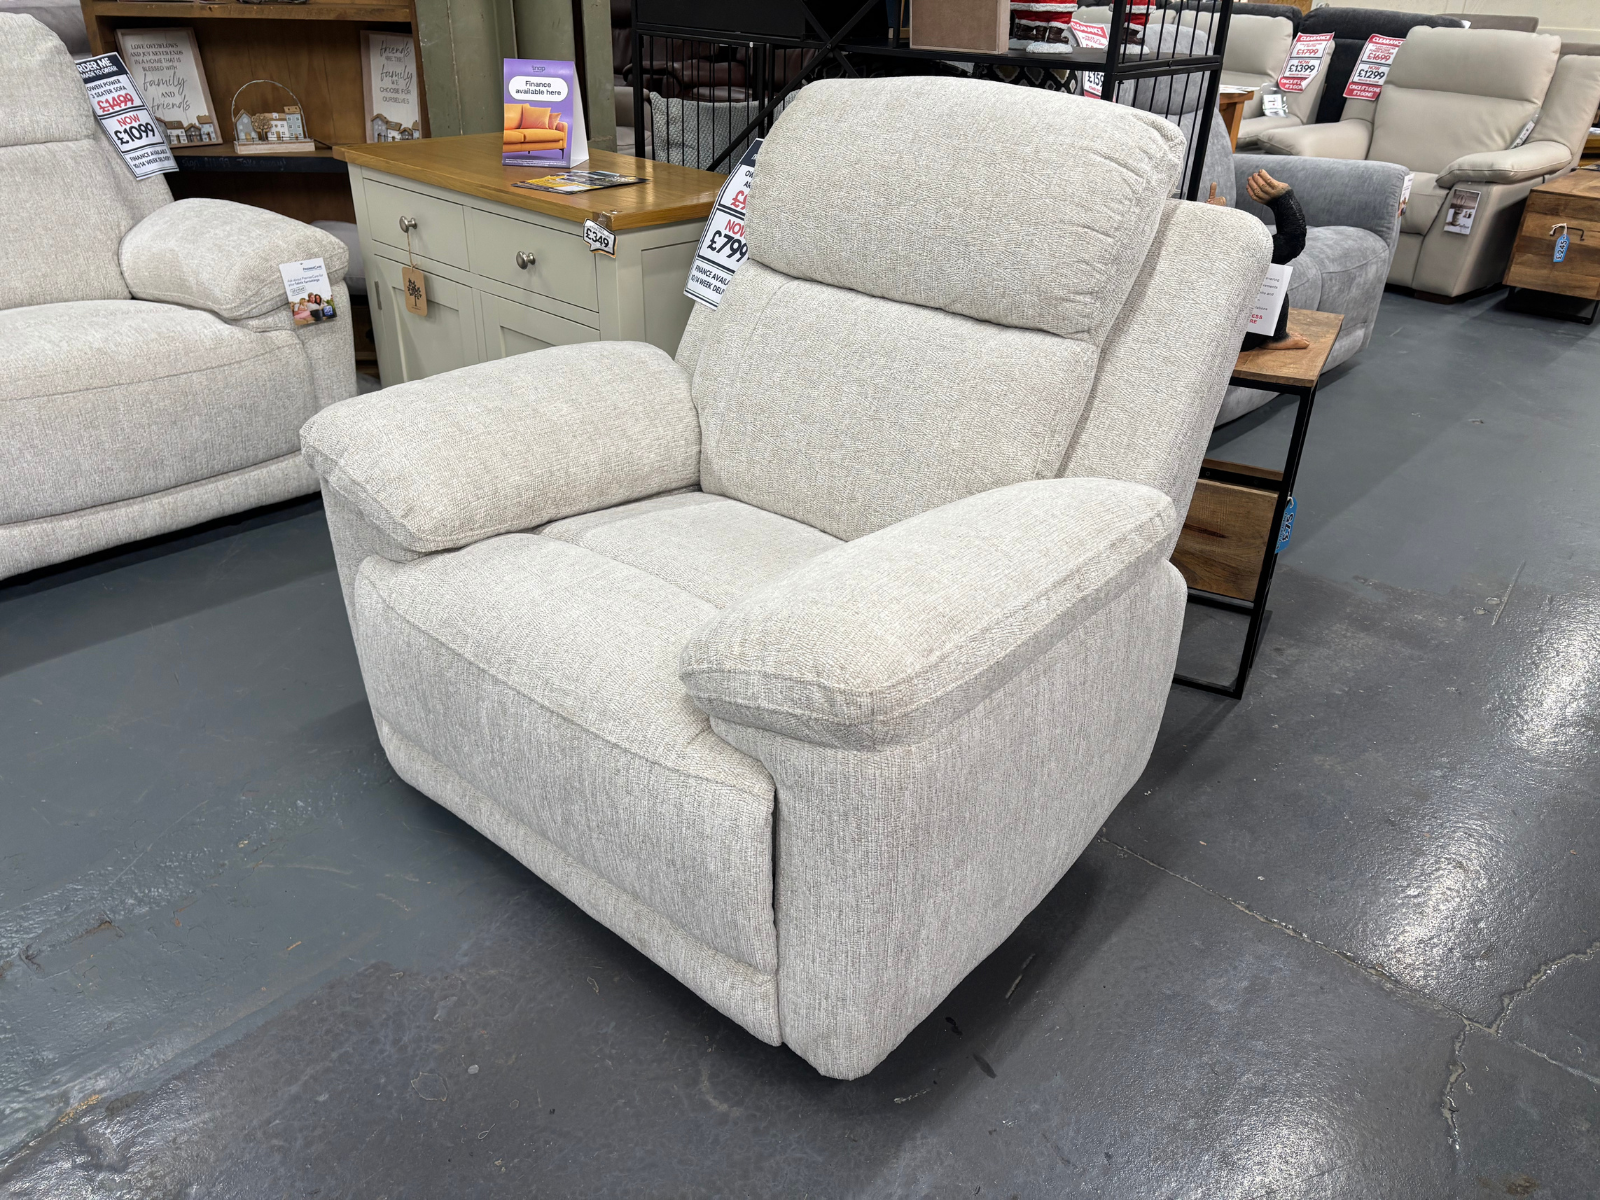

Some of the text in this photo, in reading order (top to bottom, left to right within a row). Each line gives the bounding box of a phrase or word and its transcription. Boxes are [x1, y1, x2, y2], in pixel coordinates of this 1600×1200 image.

[1372, 37, 1403, 46] CLEARANC
[1296, 48, 1320, 56] £1799
[1367, 52, 1391, 62] £1699
[76, 57, 112, 73] RDER ME
[101, 65, 119, 74] ORDER
[1288, 64, 1316, 73] £1399
[381, 63, 413, 89] family
[1357, 68, 1386, 80] £1299
[103, 78, 122, 88] POWER
[143, 71, 187, 95] family
[525, 80, 552, 88] Finance
[95, 88, 114, 98] SEATER
[114, 85, 127, 93] SOFA
[380, 86, 400, 95] CHOOSE
[515, 88, 562, 96] available here
[97, 92, 135, 114] £1499
[151, 94, 191, 114] friends
[382, 95, 410, 105] OURSELVES
[116, 113, 141, 127] NOW
[114, 122, 156, 146] £1099
[130, 151, 150, 162] FINANCE
[585, 228, 610, 248] £349
[706, 230, 749, 263] £799
[695, 264, 713, 278] FINANCE
[699, 277, 713, 290] WEEK
